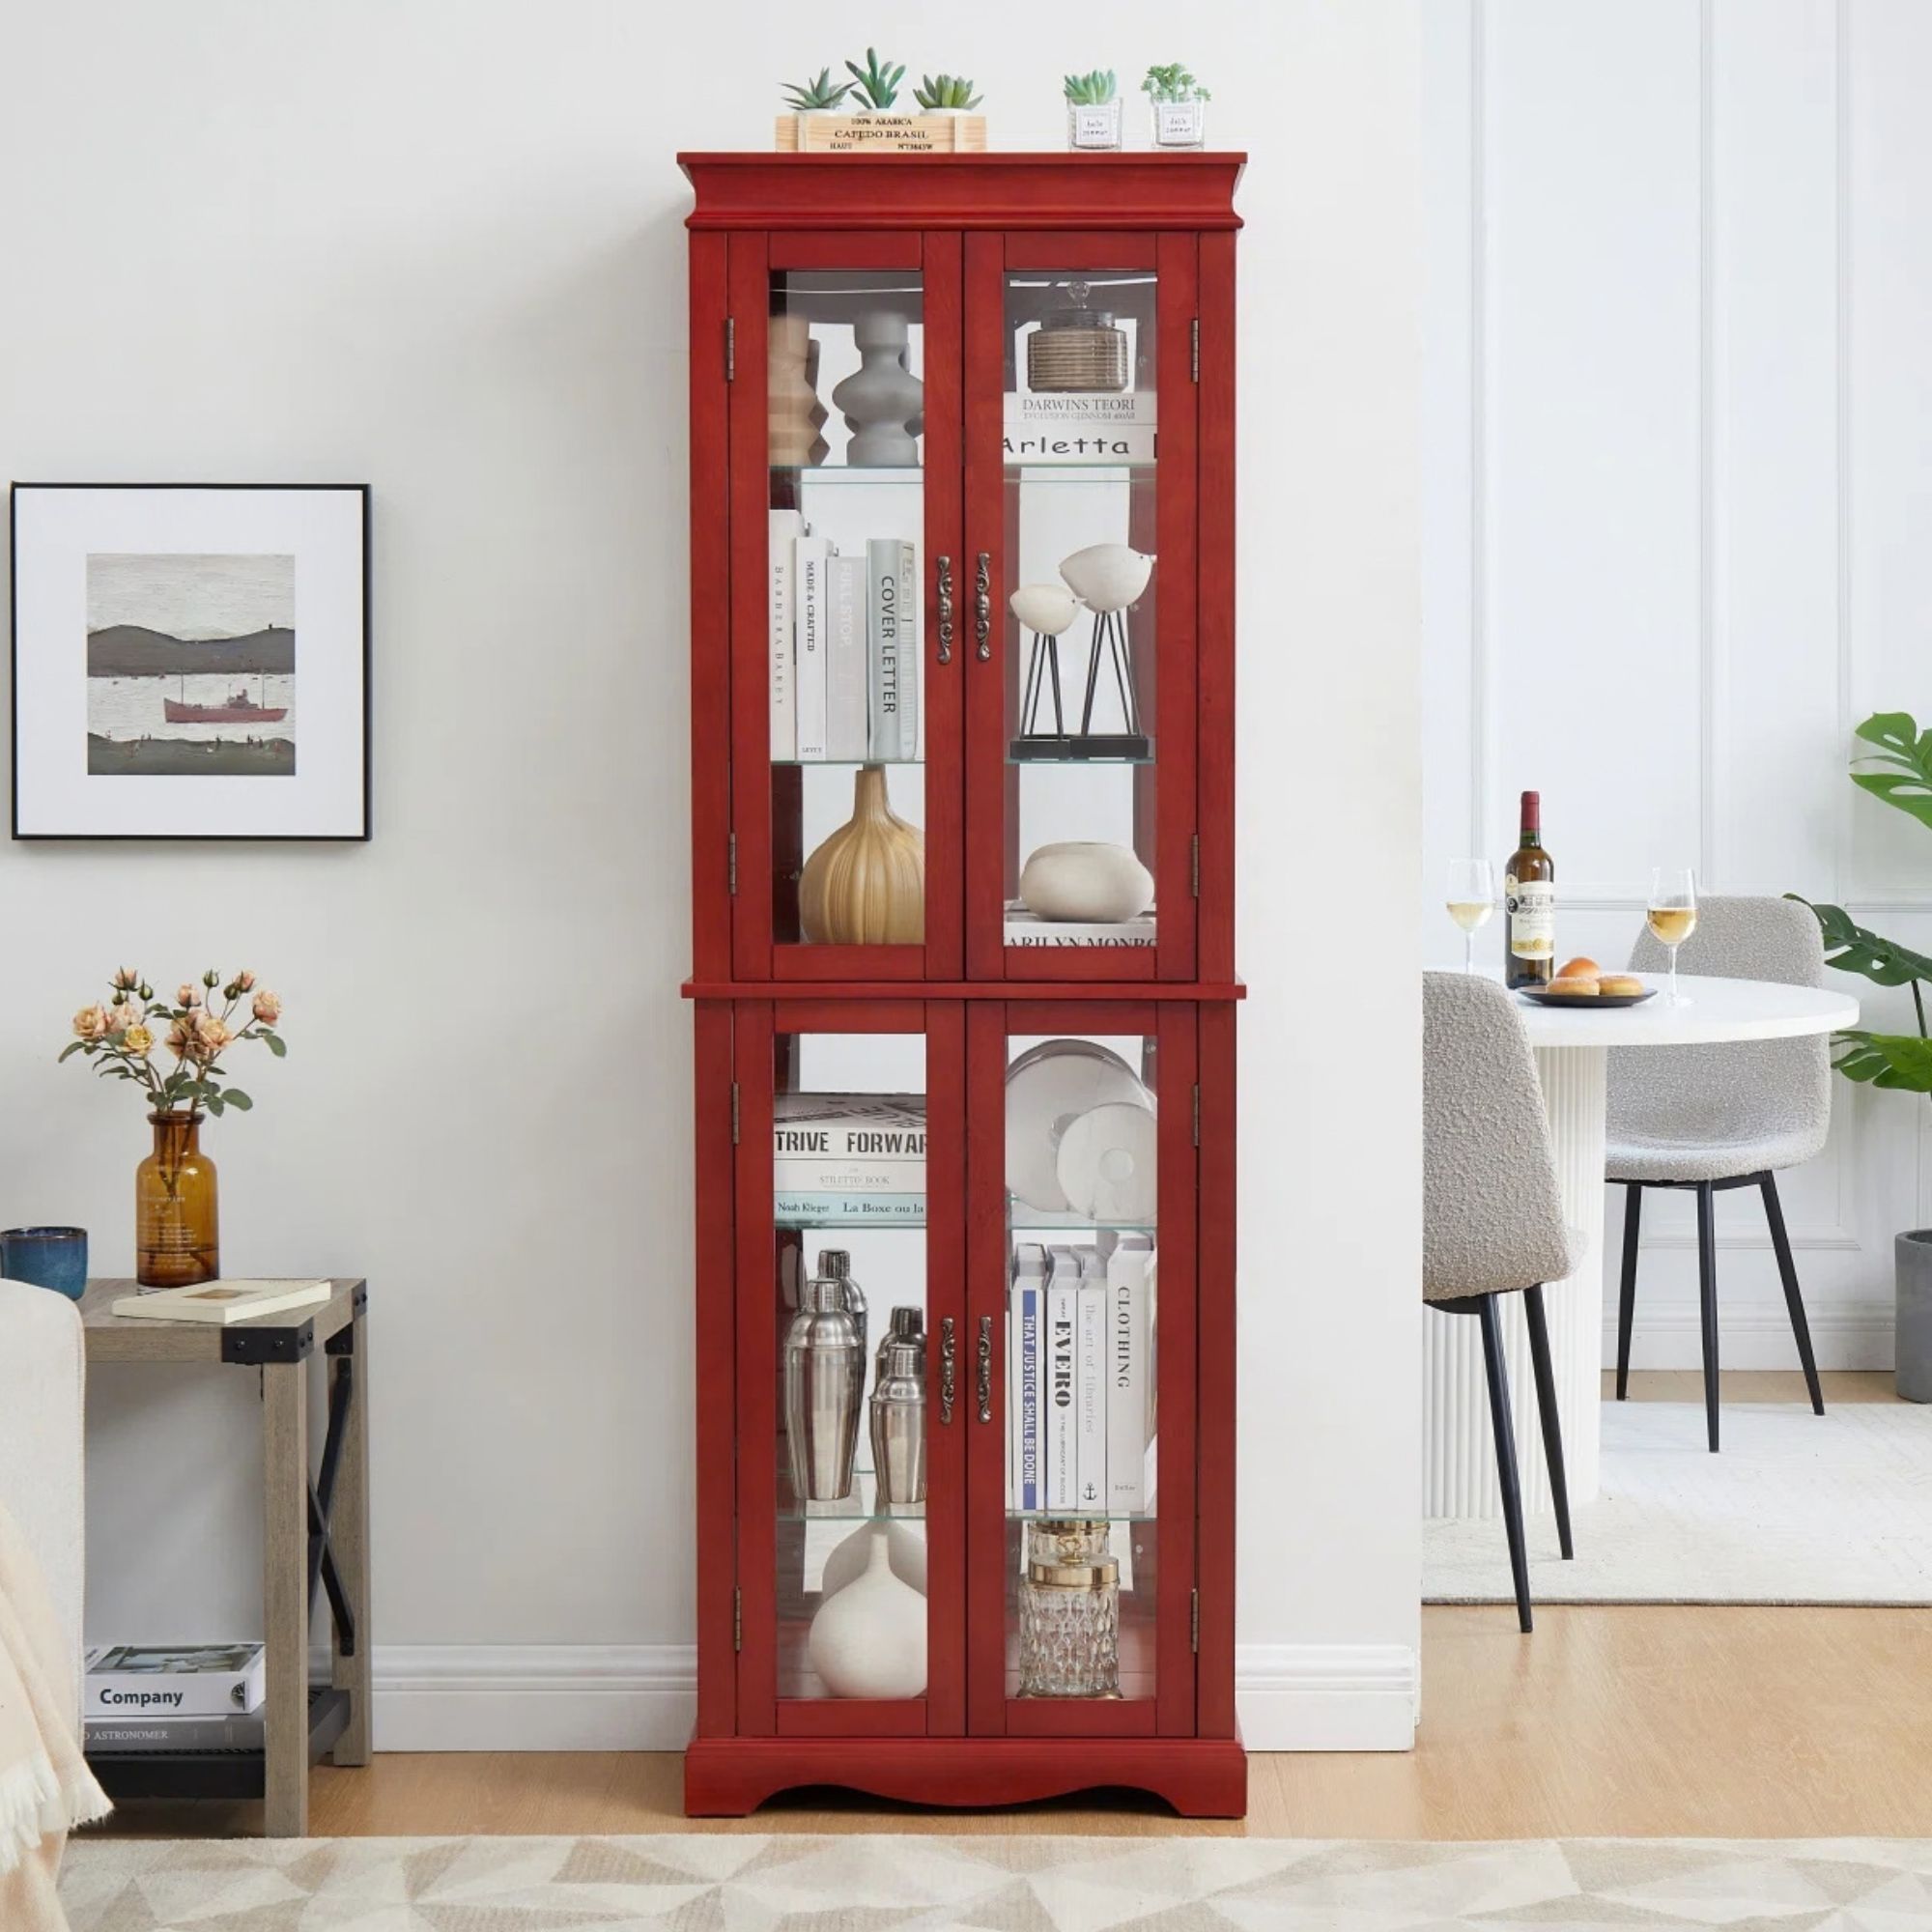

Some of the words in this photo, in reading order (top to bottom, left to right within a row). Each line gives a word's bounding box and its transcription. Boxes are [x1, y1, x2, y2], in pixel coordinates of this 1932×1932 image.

[885, 130, 929, 139] BRASIL
[1022, 399, 1089, 411] DARWINS
[1092, 399, 1135, 411] TEORI
[1003, 437, 1130, 454] Arletta
[806, 560, 814, 593] MADE
[881, 575, 895, 639] COVER
[882, 645, 895, 713] LETTER
[778, 1202, 800, 1212] Noah
[842, 1202, 858, 1212] La
[862, 1203, 892, 1212] Boxe
[1024, 1315, 1036, 1347] THAT
[1118, 1286, 1130, 1388] CLOTHING
[1024, 1350, 1036, 1397] JUSTICE
[1055, 1321, 1070, 1407] EVERO
[1024, 1401, 1036, 1435] SHALL
[1024, 1437, 1036, 1451] BE
[1024, 1454, 1036, 1485] DONE
[99, 1689, 184, 1707] Company
[94, 1730, 168, 1740] ASTRONOMER
